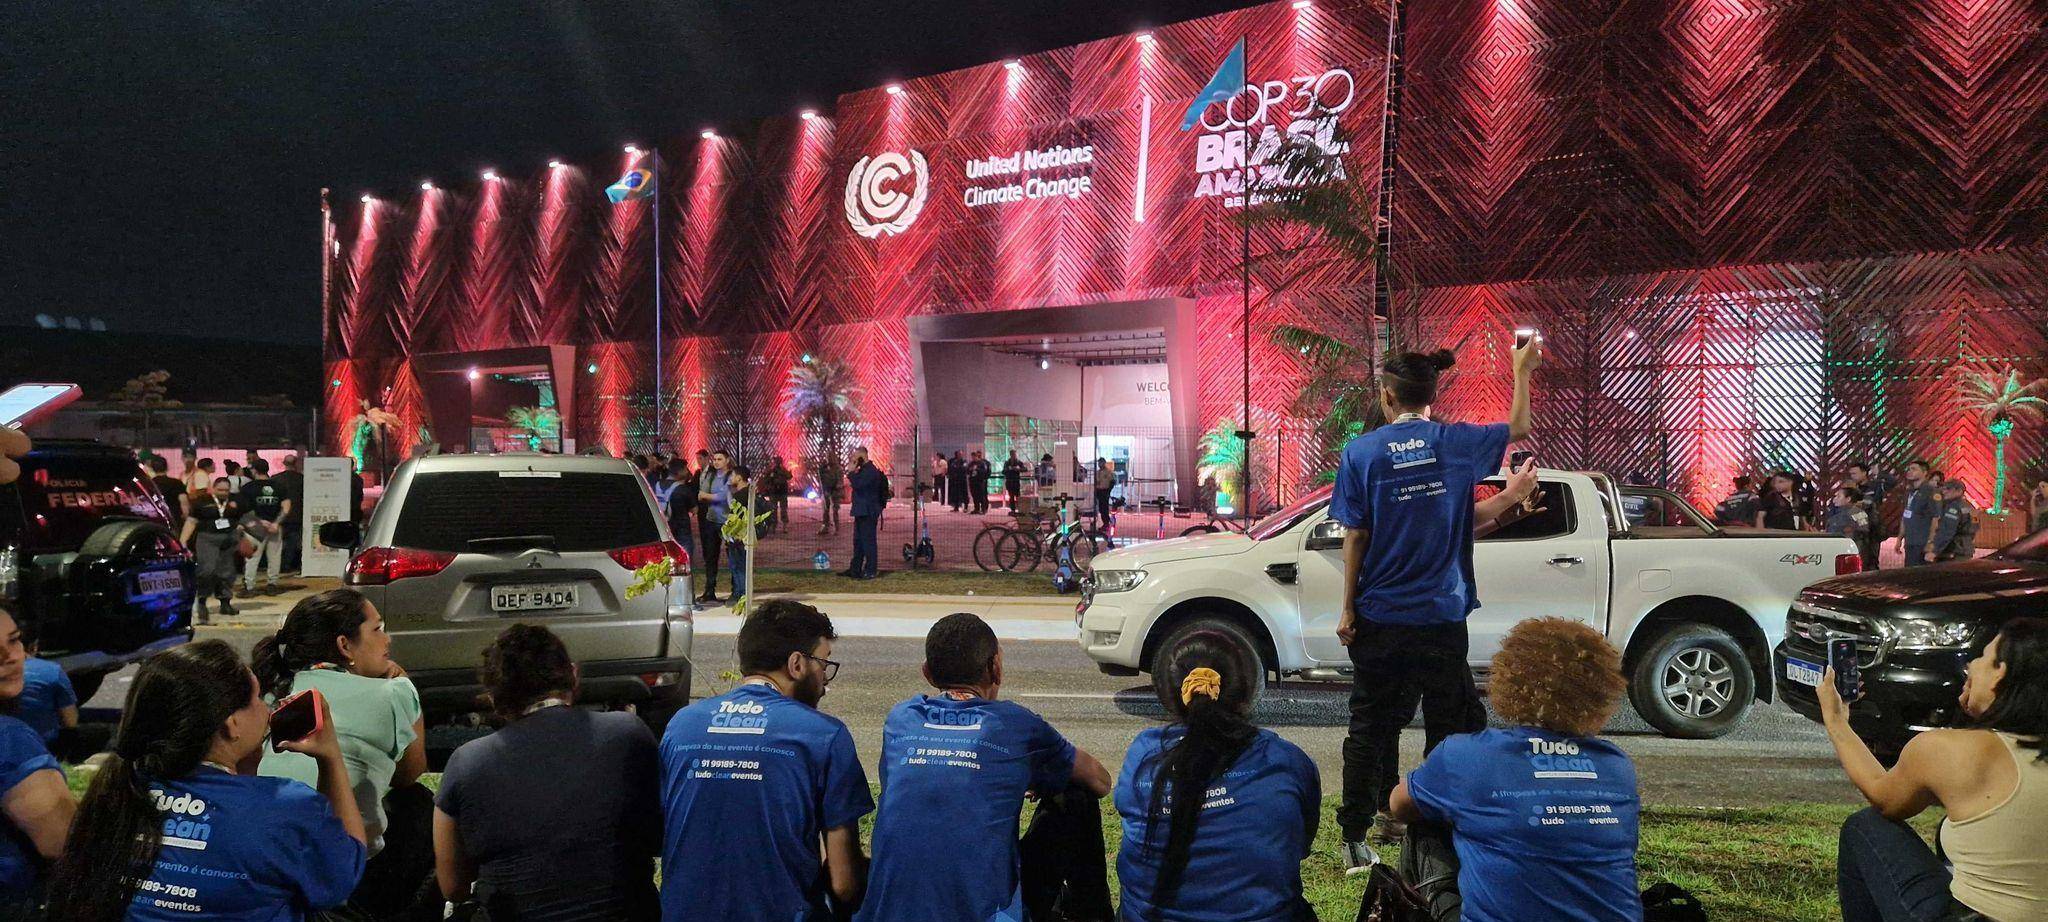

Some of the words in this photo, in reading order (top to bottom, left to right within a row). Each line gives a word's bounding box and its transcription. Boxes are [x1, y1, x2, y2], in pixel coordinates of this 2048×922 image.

[966, 151, 1020, 178] United
[1023, 145, 1093, 171] Nations
[964, 184, 1023, 207] Climate
[1025, 175, 1091, 199] Change
[1136, 382, 1170, 392] WELC
[1387, 438, 1426, 453] Tudo
[1391, 448, 1437, 464] Clean
[718, 700, 764, 715] Tudo
[711, 713, 769, 729] Clean
[926, 707, 984, 726] Clean
[727, 744, 754, 752] evento
[926, 748, 978, 760] 99189-7808
[1528, 737, 1580, 756] Tudo
[701, 759, 710, 768] 91
[710, 759, 760, 770] 99189-7808
[1531, 754, 1596, 772] Clean
[1545, 805, 1558, 814] 91
[1558, 805, 1612, 814] 99189-7808
[163, 818, 212, 842] ean
[190, 862, 198, 875] é
